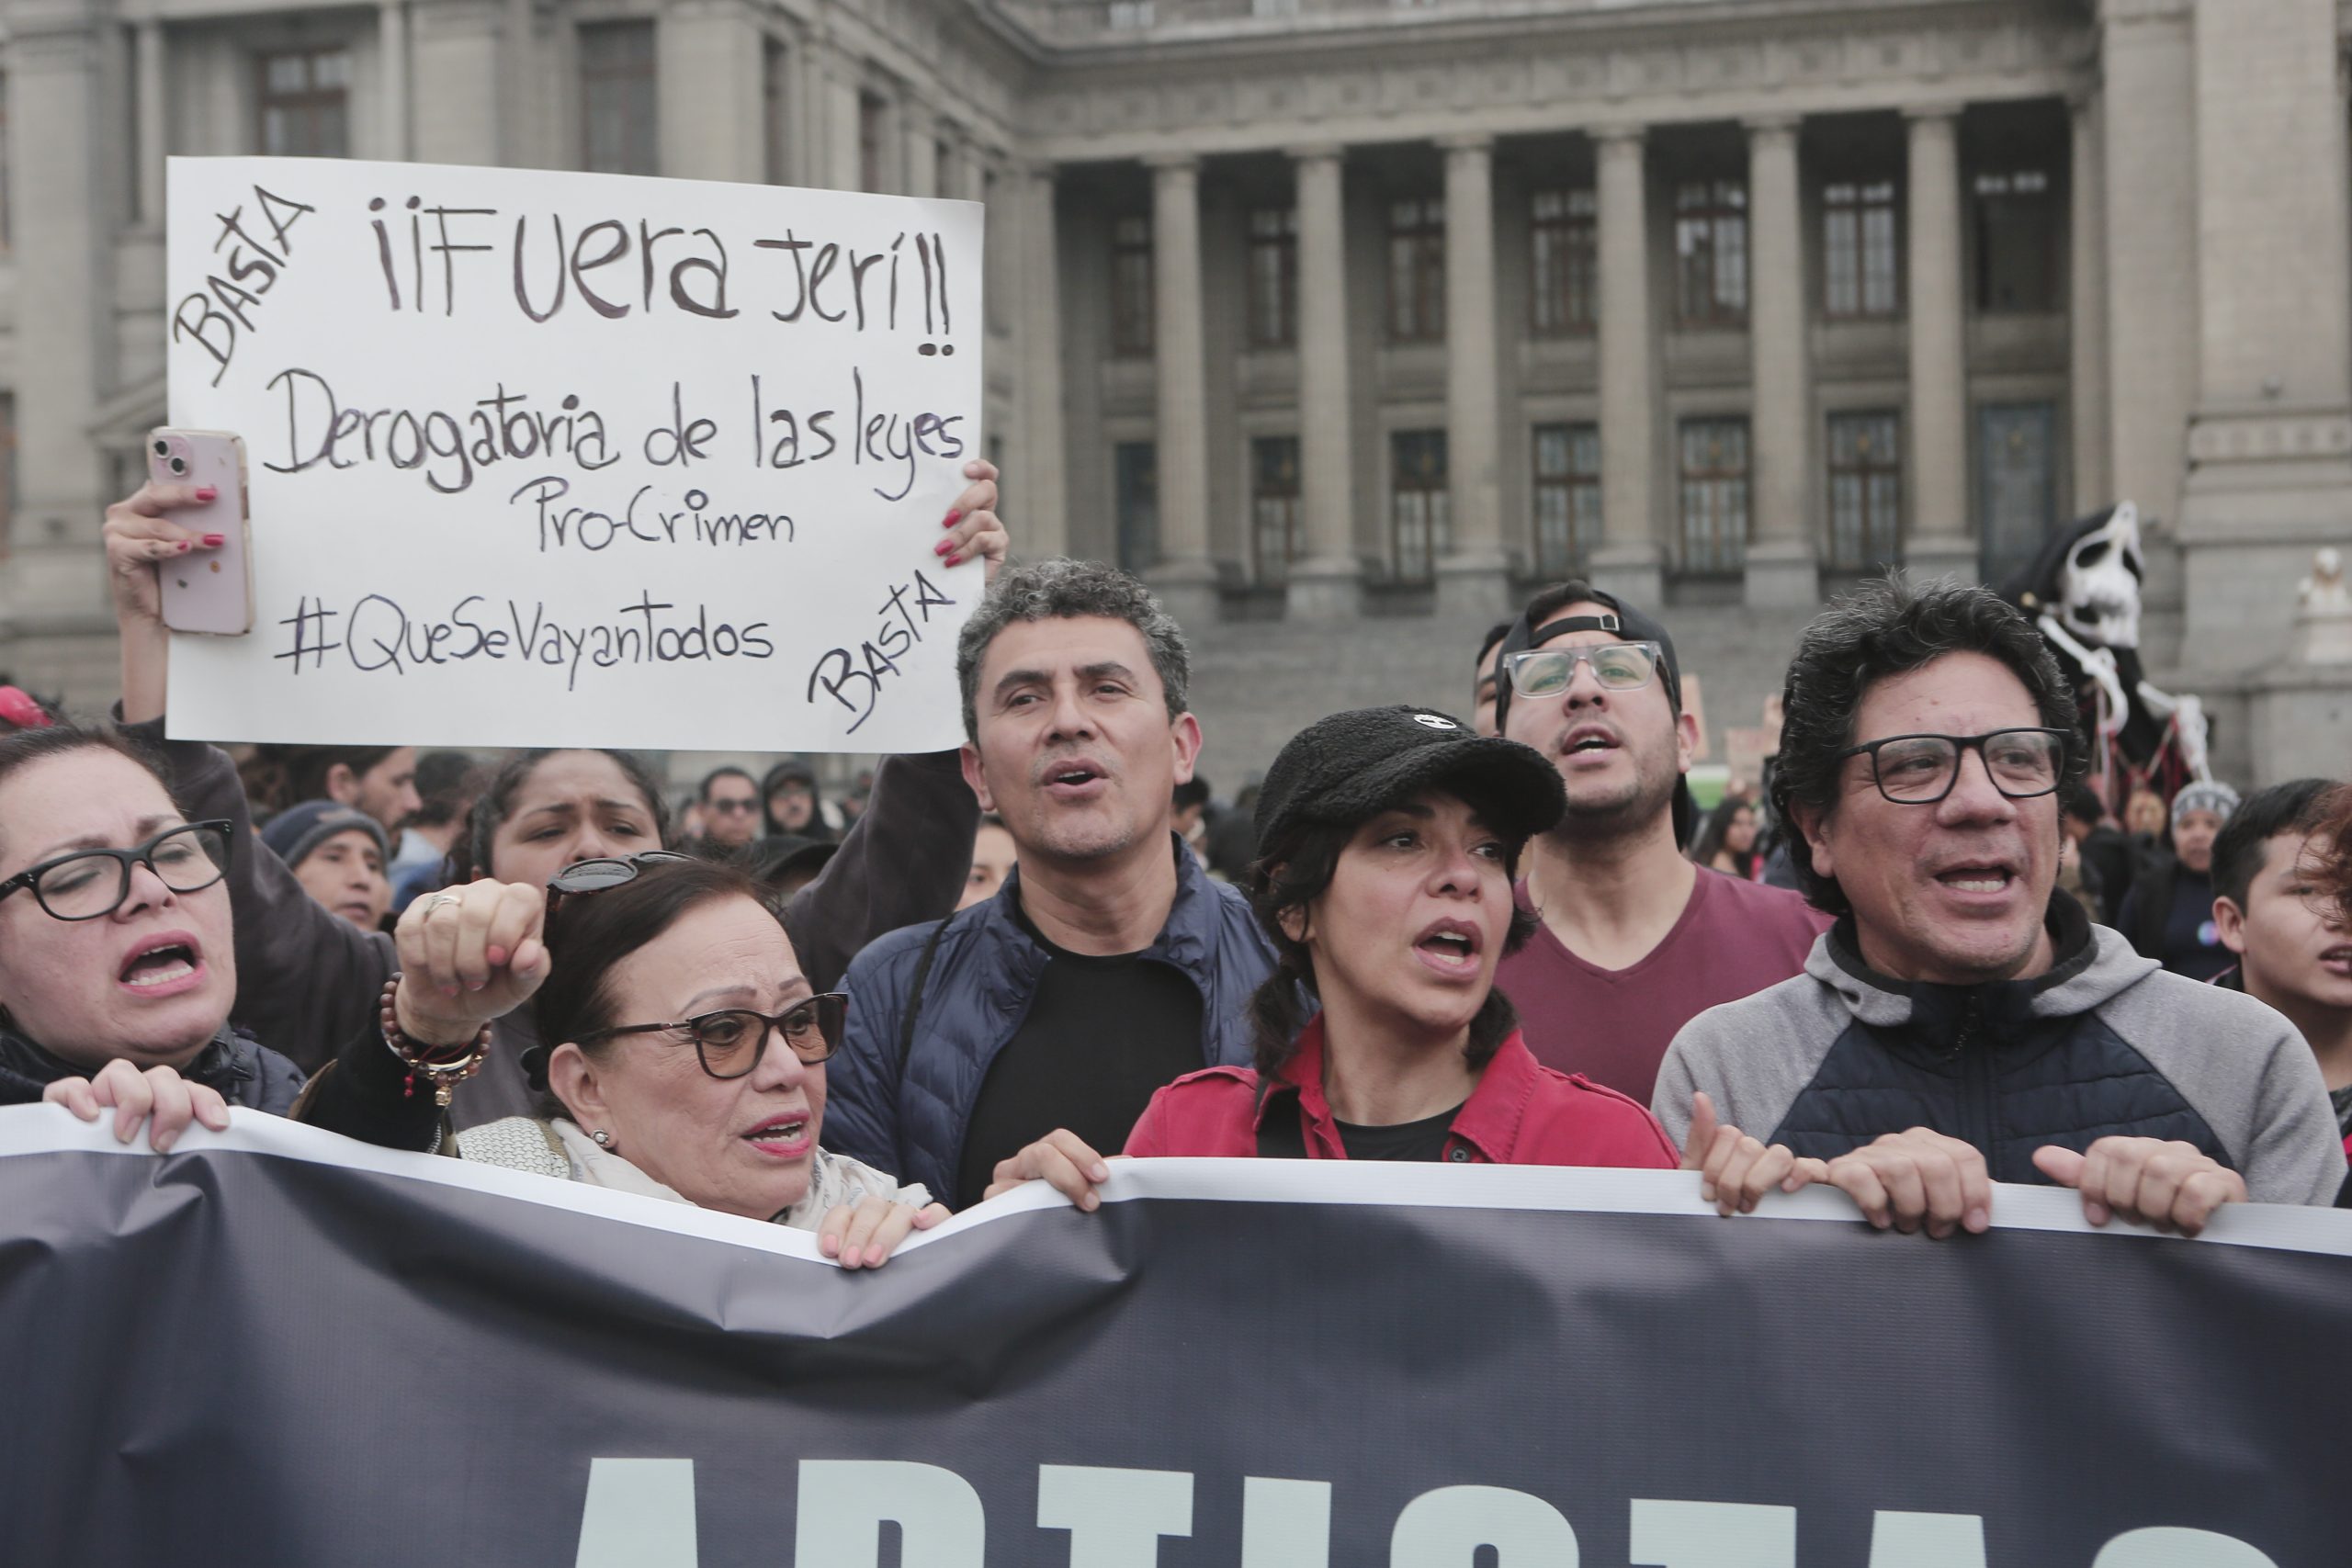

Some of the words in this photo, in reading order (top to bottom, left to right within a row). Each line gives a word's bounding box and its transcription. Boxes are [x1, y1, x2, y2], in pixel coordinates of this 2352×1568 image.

[173, 184, 316, 389] BASTA
[263, 367, 621, 494] Derogatoria
[643, 380, 719, 468] de
[751, 374, 837, 469] las
[853, 366, 965, 502] leyes
[509, 475, 796, 553] Pro-Crimen
[273, 589, 775, 692] #QueSeVayanTodos
[807, 568, 957, 736] BASTA
